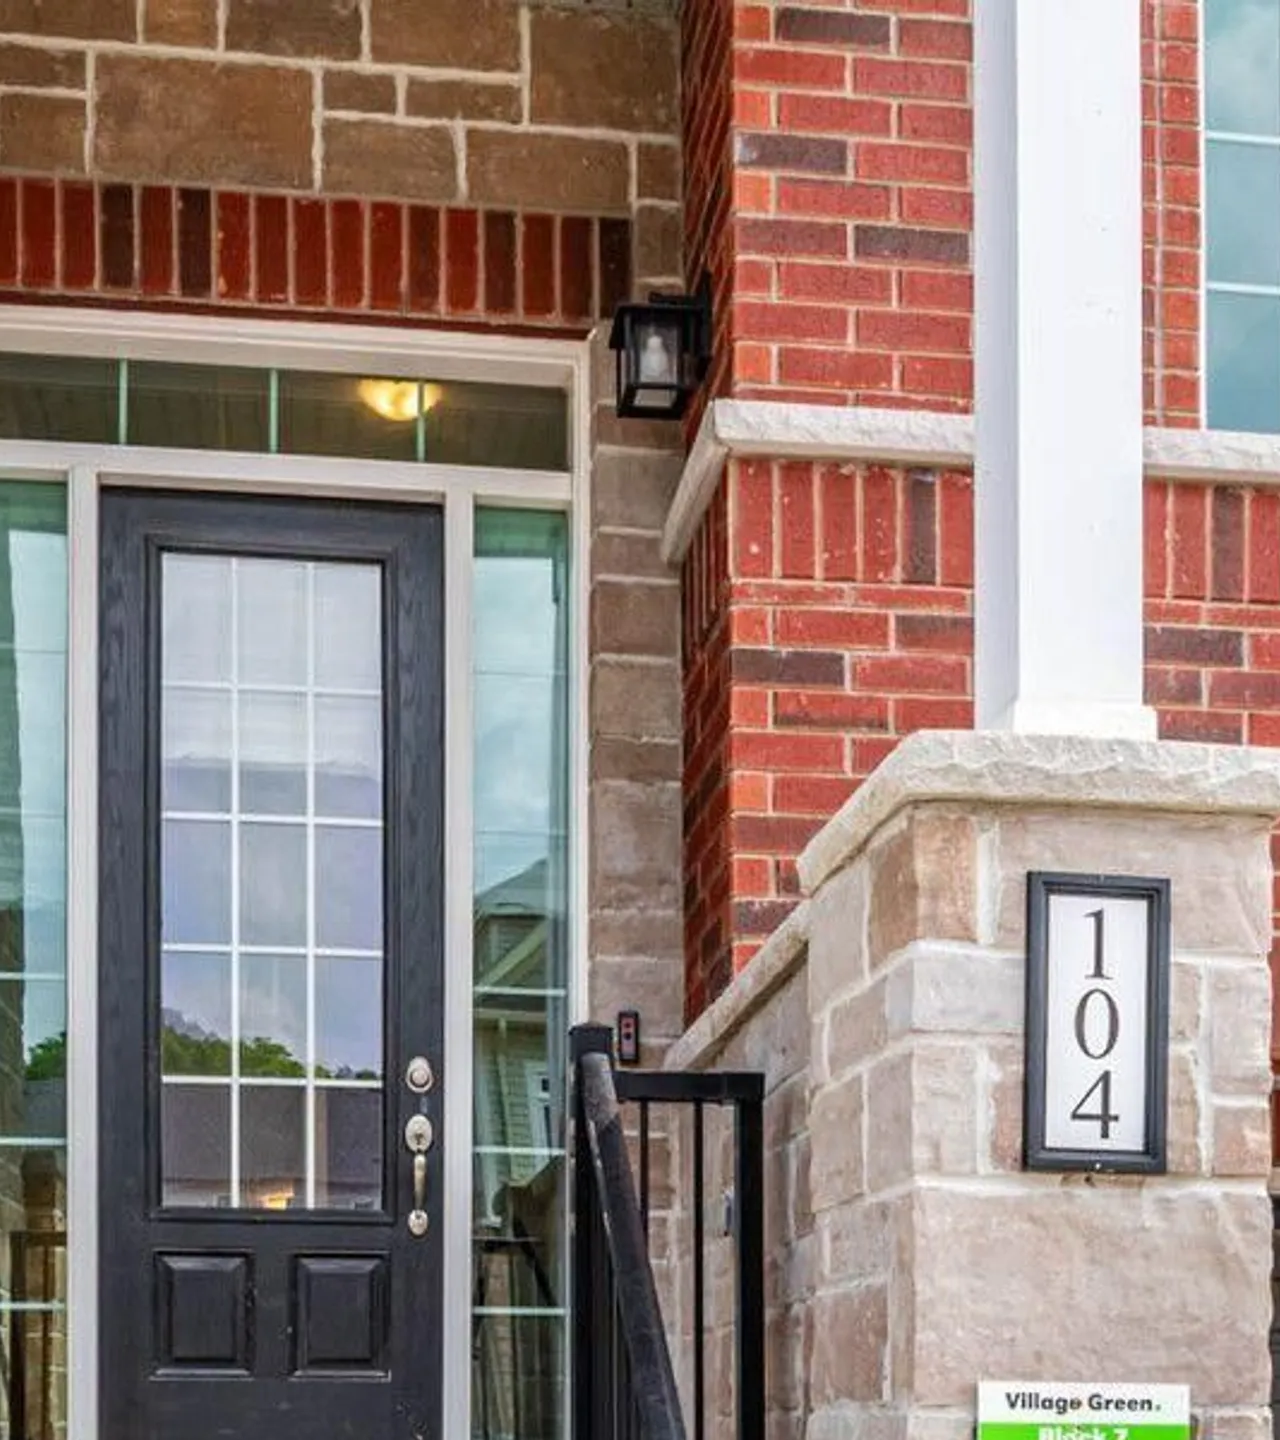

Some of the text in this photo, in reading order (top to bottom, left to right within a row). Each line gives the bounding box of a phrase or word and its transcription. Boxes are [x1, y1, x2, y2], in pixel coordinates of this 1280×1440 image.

[1070, 907, 1120, 1139] 104
[1005, 1392, 1161, 1415] Village Green.
